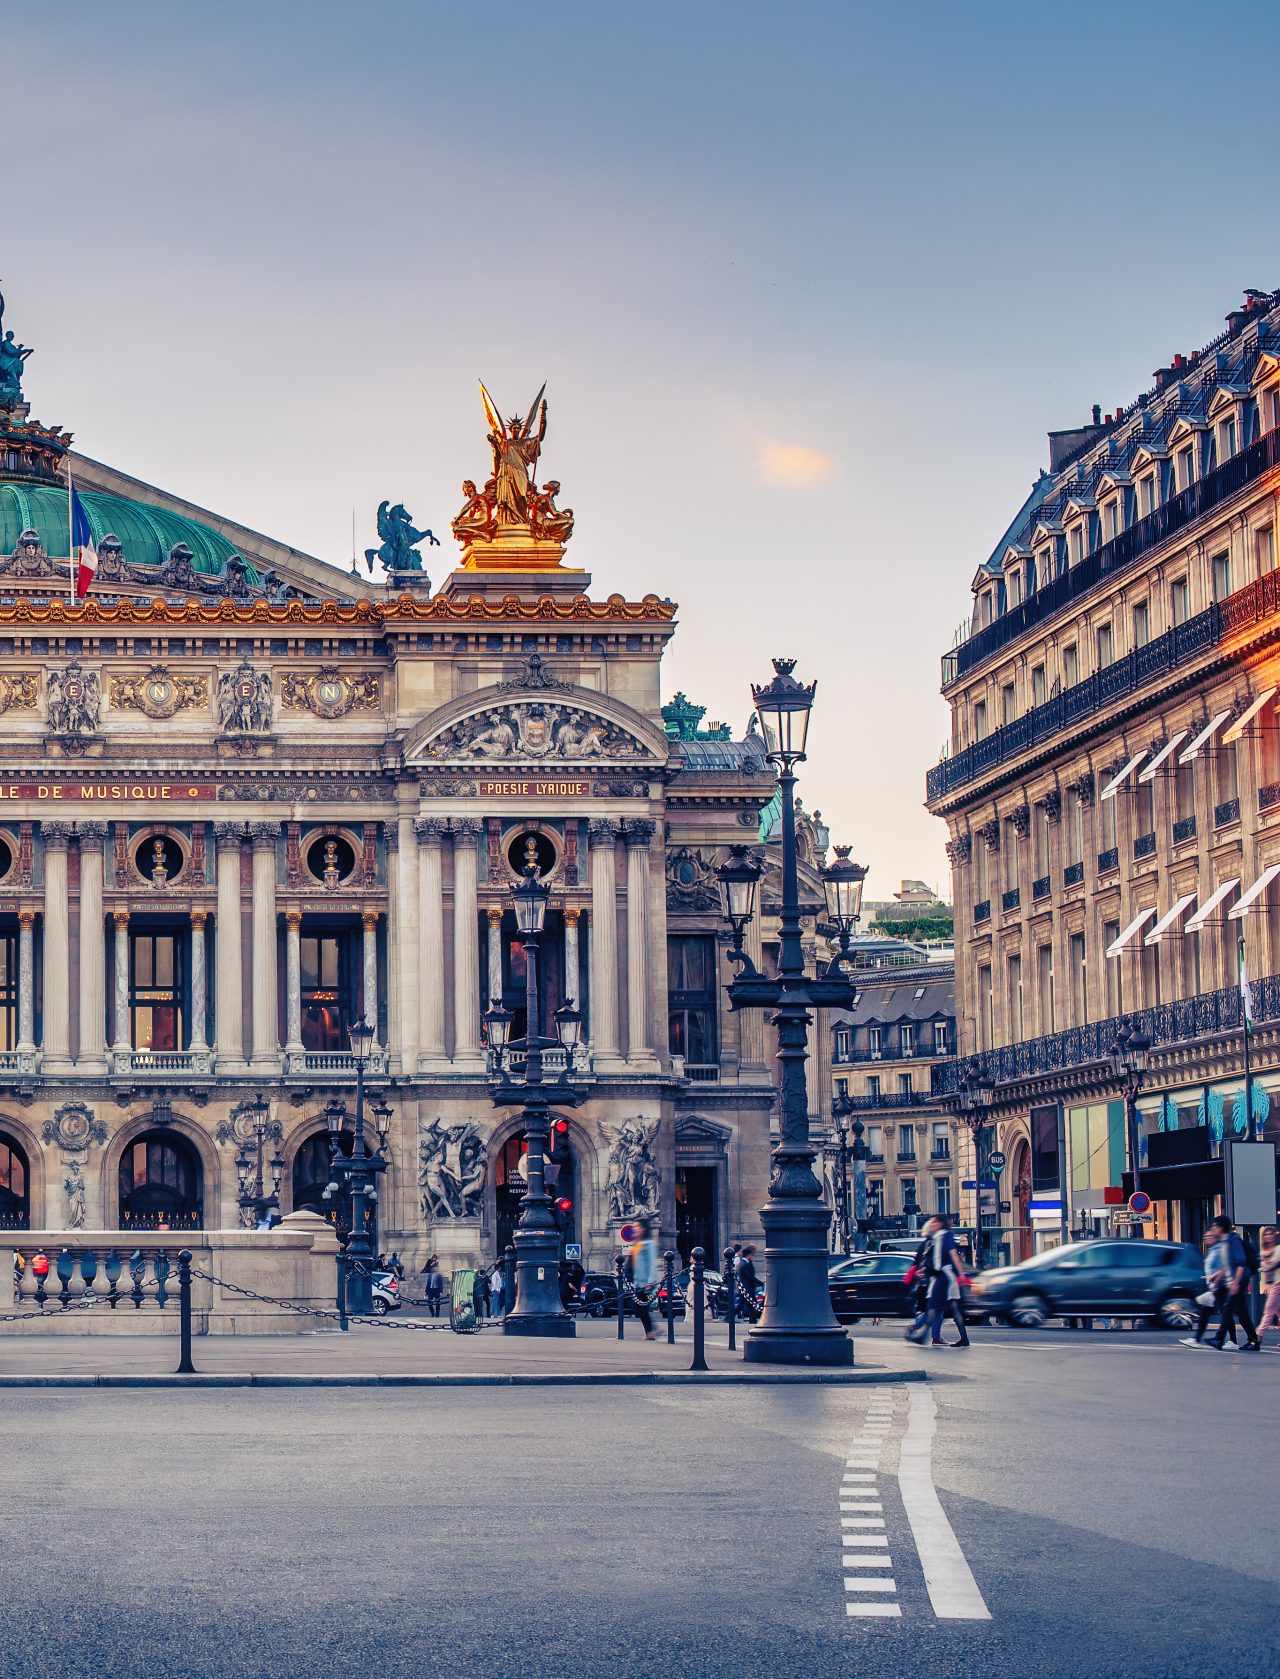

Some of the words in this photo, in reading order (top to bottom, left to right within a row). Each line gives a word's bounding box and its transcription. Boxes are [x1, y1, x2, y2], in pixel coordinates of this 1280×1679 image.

[69, 685, 78, 696] E
[153, 686, 165, 698] N
[241, 685, 250, 696] E
[324, 686, 336, 698] N
[38, 785, 63, 799] DE
[81, 785, 171, 800] MUSIQUE
[487, 783, 529, 795] POESIE
[536, 783, 583, 796] LYRIQUE
